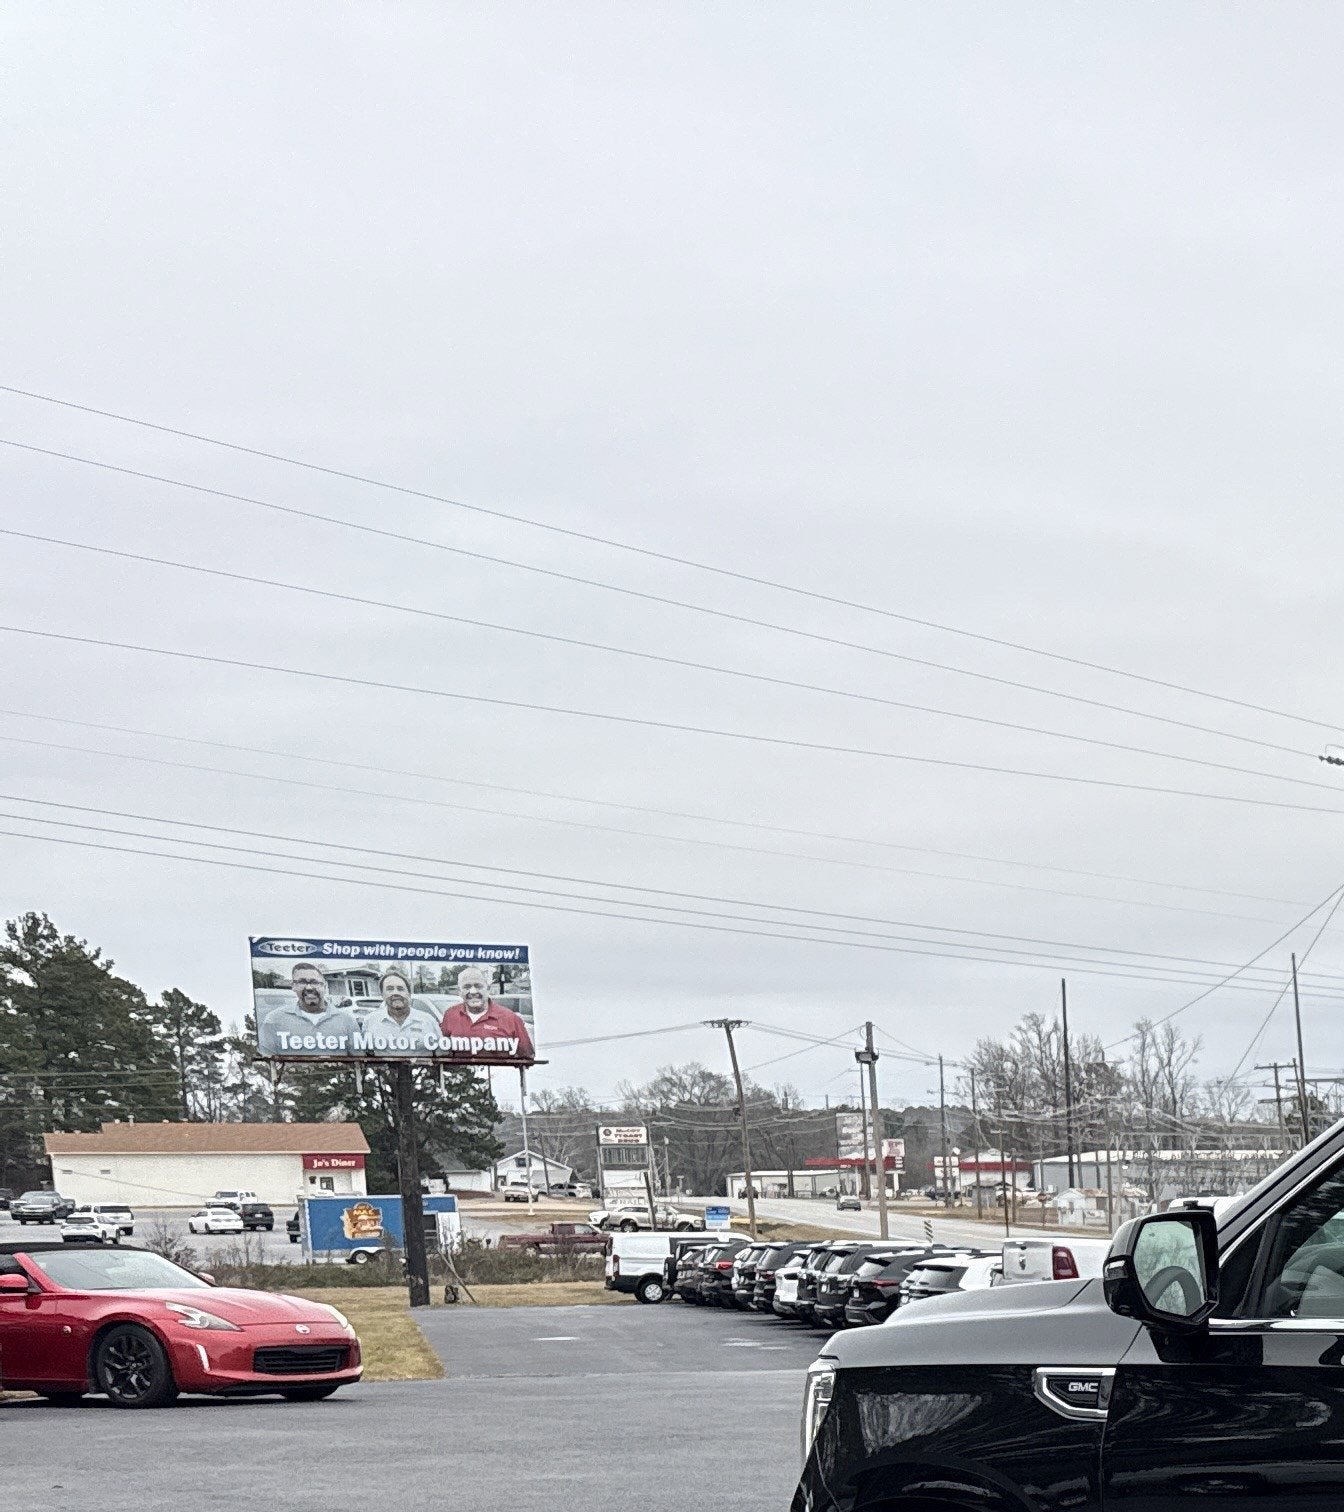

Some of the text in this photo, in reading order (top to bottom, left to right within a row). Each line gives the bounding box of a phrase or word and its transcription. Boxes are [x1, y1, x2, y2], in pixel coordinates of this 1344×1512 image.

[267, 942, 311, 953] Teeter
[322, 943, 521, 961] Shop with people you know!
[276, 1031, 520, 1055] Teeter Motor Company
[331, 1158, 356, 1168] Diner
[1068, 1381, 1098, 1393] GMC
